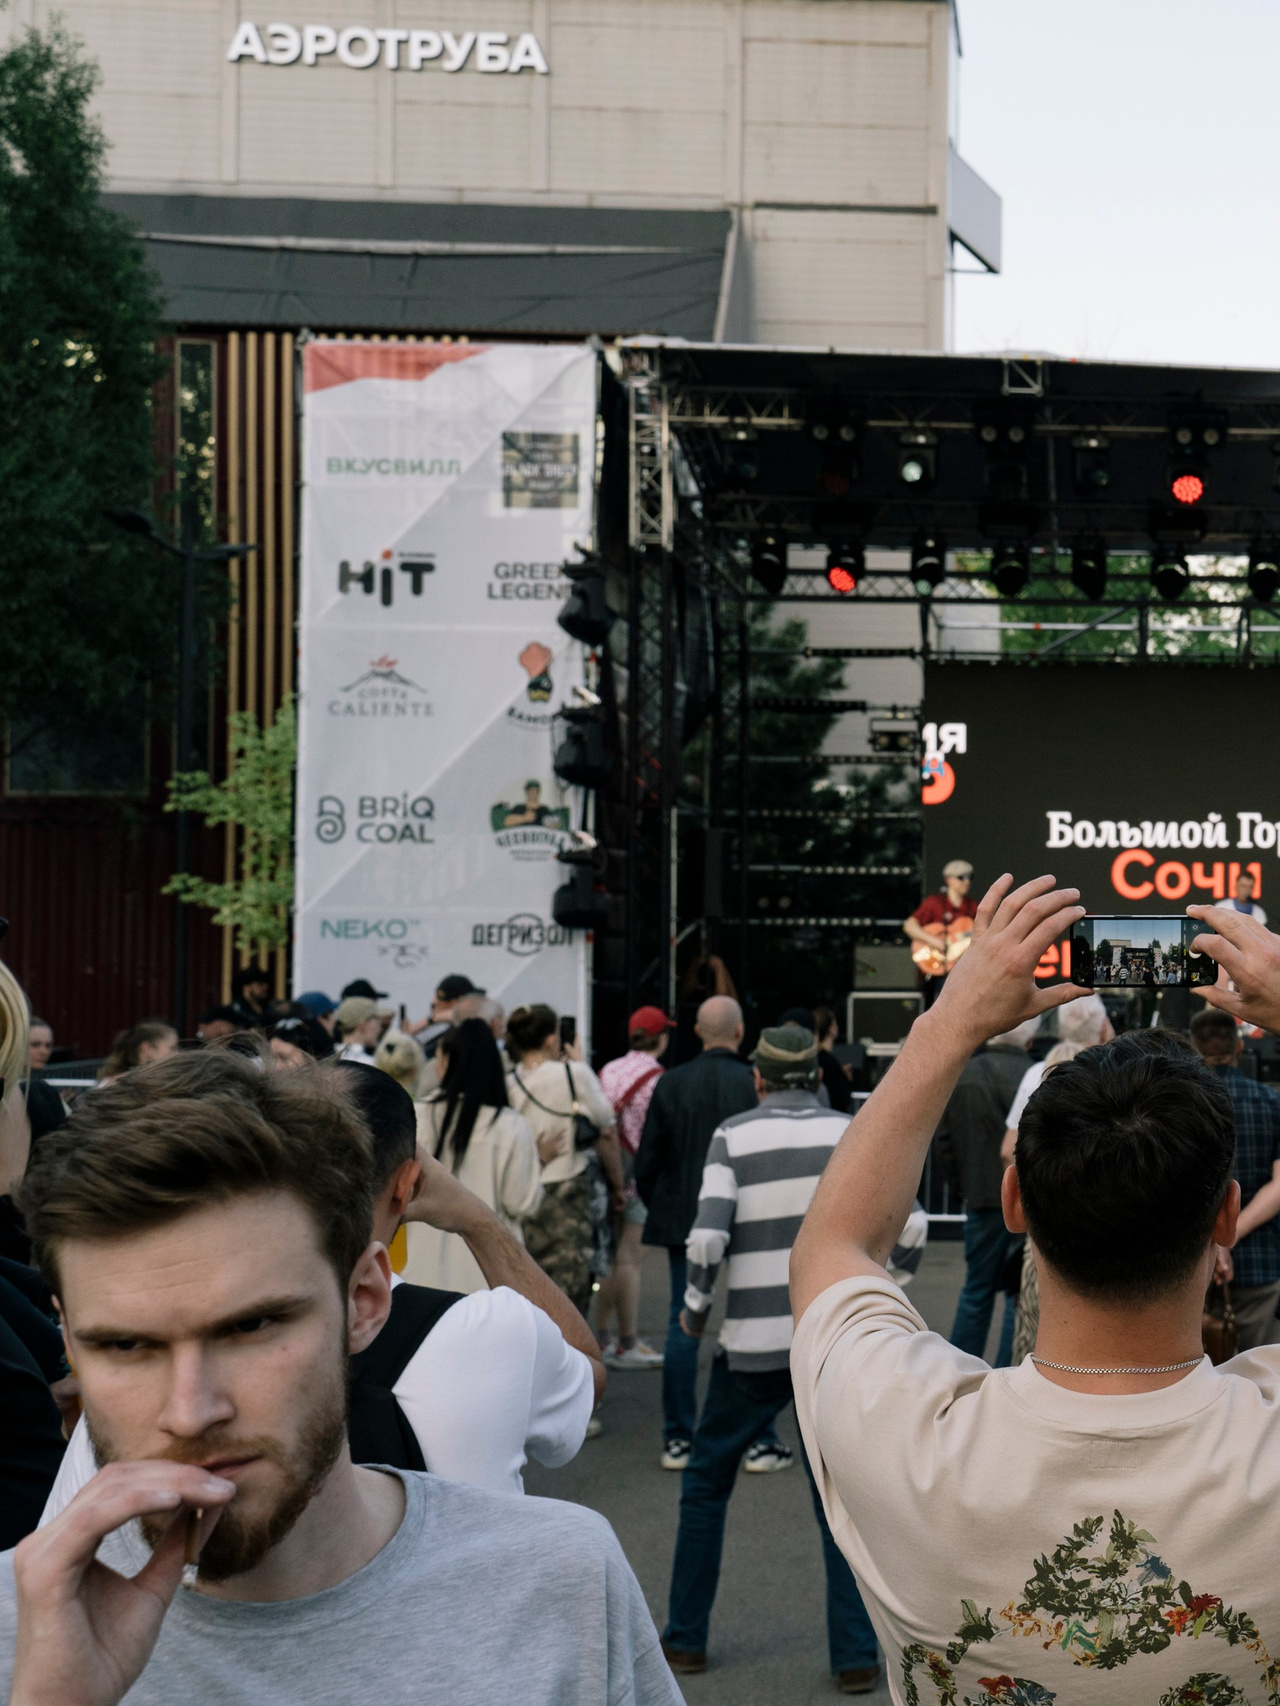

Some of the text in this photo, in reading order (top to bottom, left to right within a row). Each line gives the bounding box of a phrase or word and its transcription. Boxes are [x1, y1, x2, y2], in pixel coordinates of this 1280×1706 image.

[226, 21, 549, 74] АЭРОТРУБА
[494, 562, 564, 580] GREE
[327, 700, 434, 717] CALIENTE
[357, 822, 434, 843] COAL
[1045, 810, 1230, 848] Большой
[1111, 848, 1262, 899] Сочи
[320, 918, 408, 939] NEKO
